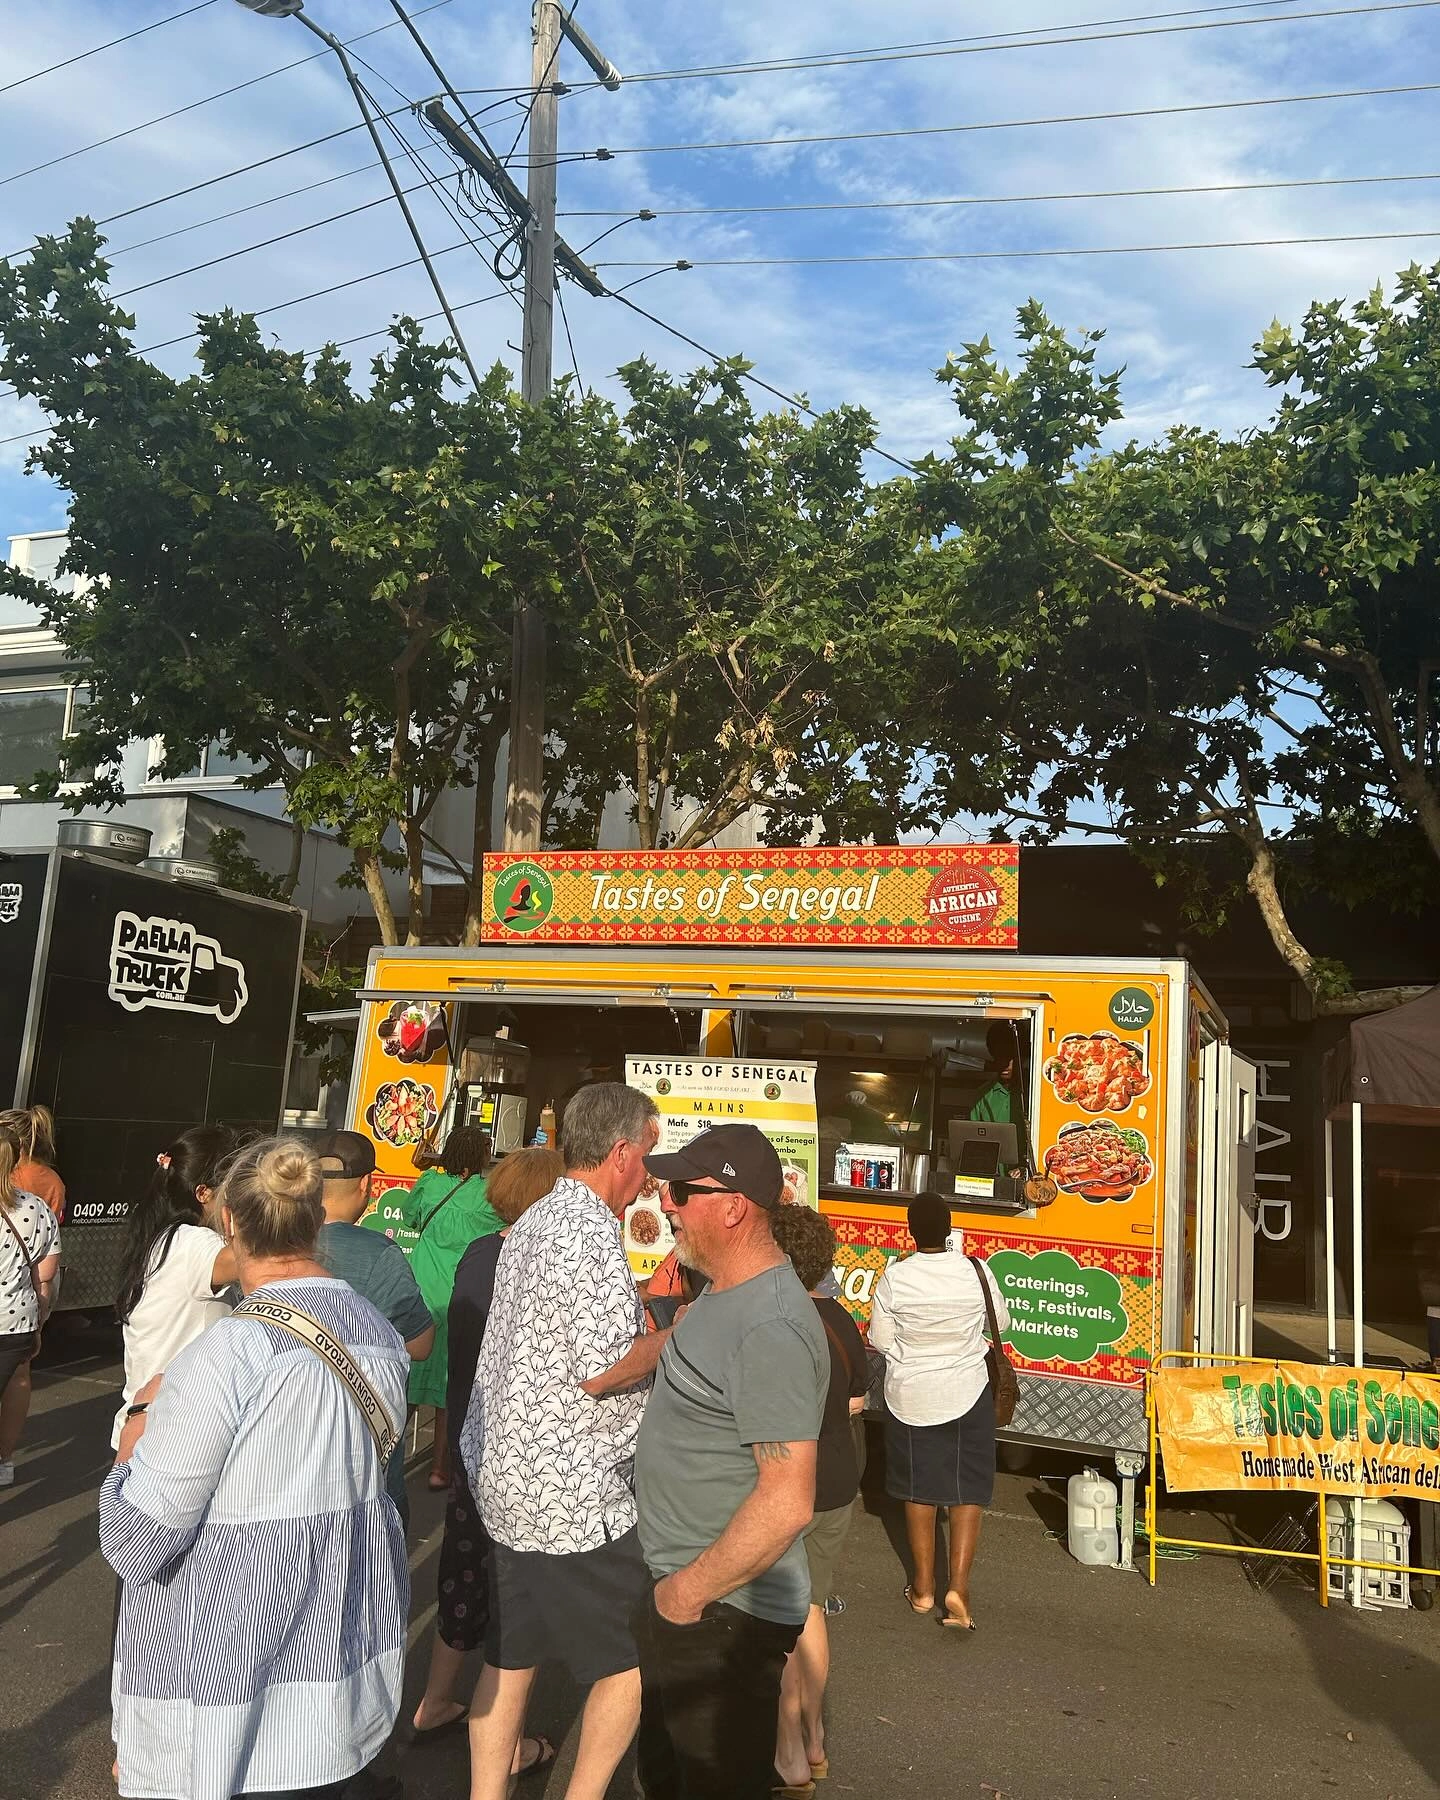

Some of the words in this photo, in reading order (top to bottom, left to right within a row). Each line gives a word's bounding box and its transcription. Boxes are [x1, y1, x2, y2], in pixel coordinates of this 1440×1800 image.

[498, 869, 518, 887] Tastes
[518, 865, 526, 875] of
[526, 865, 550, 888] Senegal
[943, 881, 980, 893] AUTHENTIC
[590, 874, 686, 911] Tastes
[696, 875, 737, 918] of
[738, 873, 880, 921] Senegal
[929, 890, 998, 914] AFRICAN
[948, 913, 981, 925] CUISINE
[118, 919, 191, 954] PAELLA
[116, 956, 188, 991] TRUCK
[155, 990, 185, 1002] com.au
[1112, 995, 1149, 1014] حلال
[1117, 1015, 1144, 1023] HALAL
[632, 1062, 693, 1077] TASTES
[702, 1065, 723, 1077] OF
[731, 1066, 808, 1083] SENEGAL
[693, 1101, 744, 1114] MAINS
[667, 1118, 688, 1127] Mafe
[697, 1119, 711, 1129] $18
[775, 1146, 796, 1154] ombo
[785, 1136, 815, 1146] Senegal
[1254, 1059, 1292, 1240] HAIR
[73, 1203, 104, 1217] 0409
[107, 1202, 129, 1216] 499
[383, 1206, 403, 1220] 04
[1004, 1274, 1089, 1298] Caterings,
[1004, 1297, 1035, 1313] nts,
[1038, 1299, 1117, 1324] Festivals,
[1011, 1318, 1079, 1339] Markets
[1222, 1375, 1323, 1440] Tastes
[1329, 1379, 1359, 1442] of
[1364, 1380, 1440, 1450] Sene
[1241, 1450, 1315, 1479] Homemade
[1318, 1453, 1357, 1482] West
[1361, 1456, 1410, 1485] African
